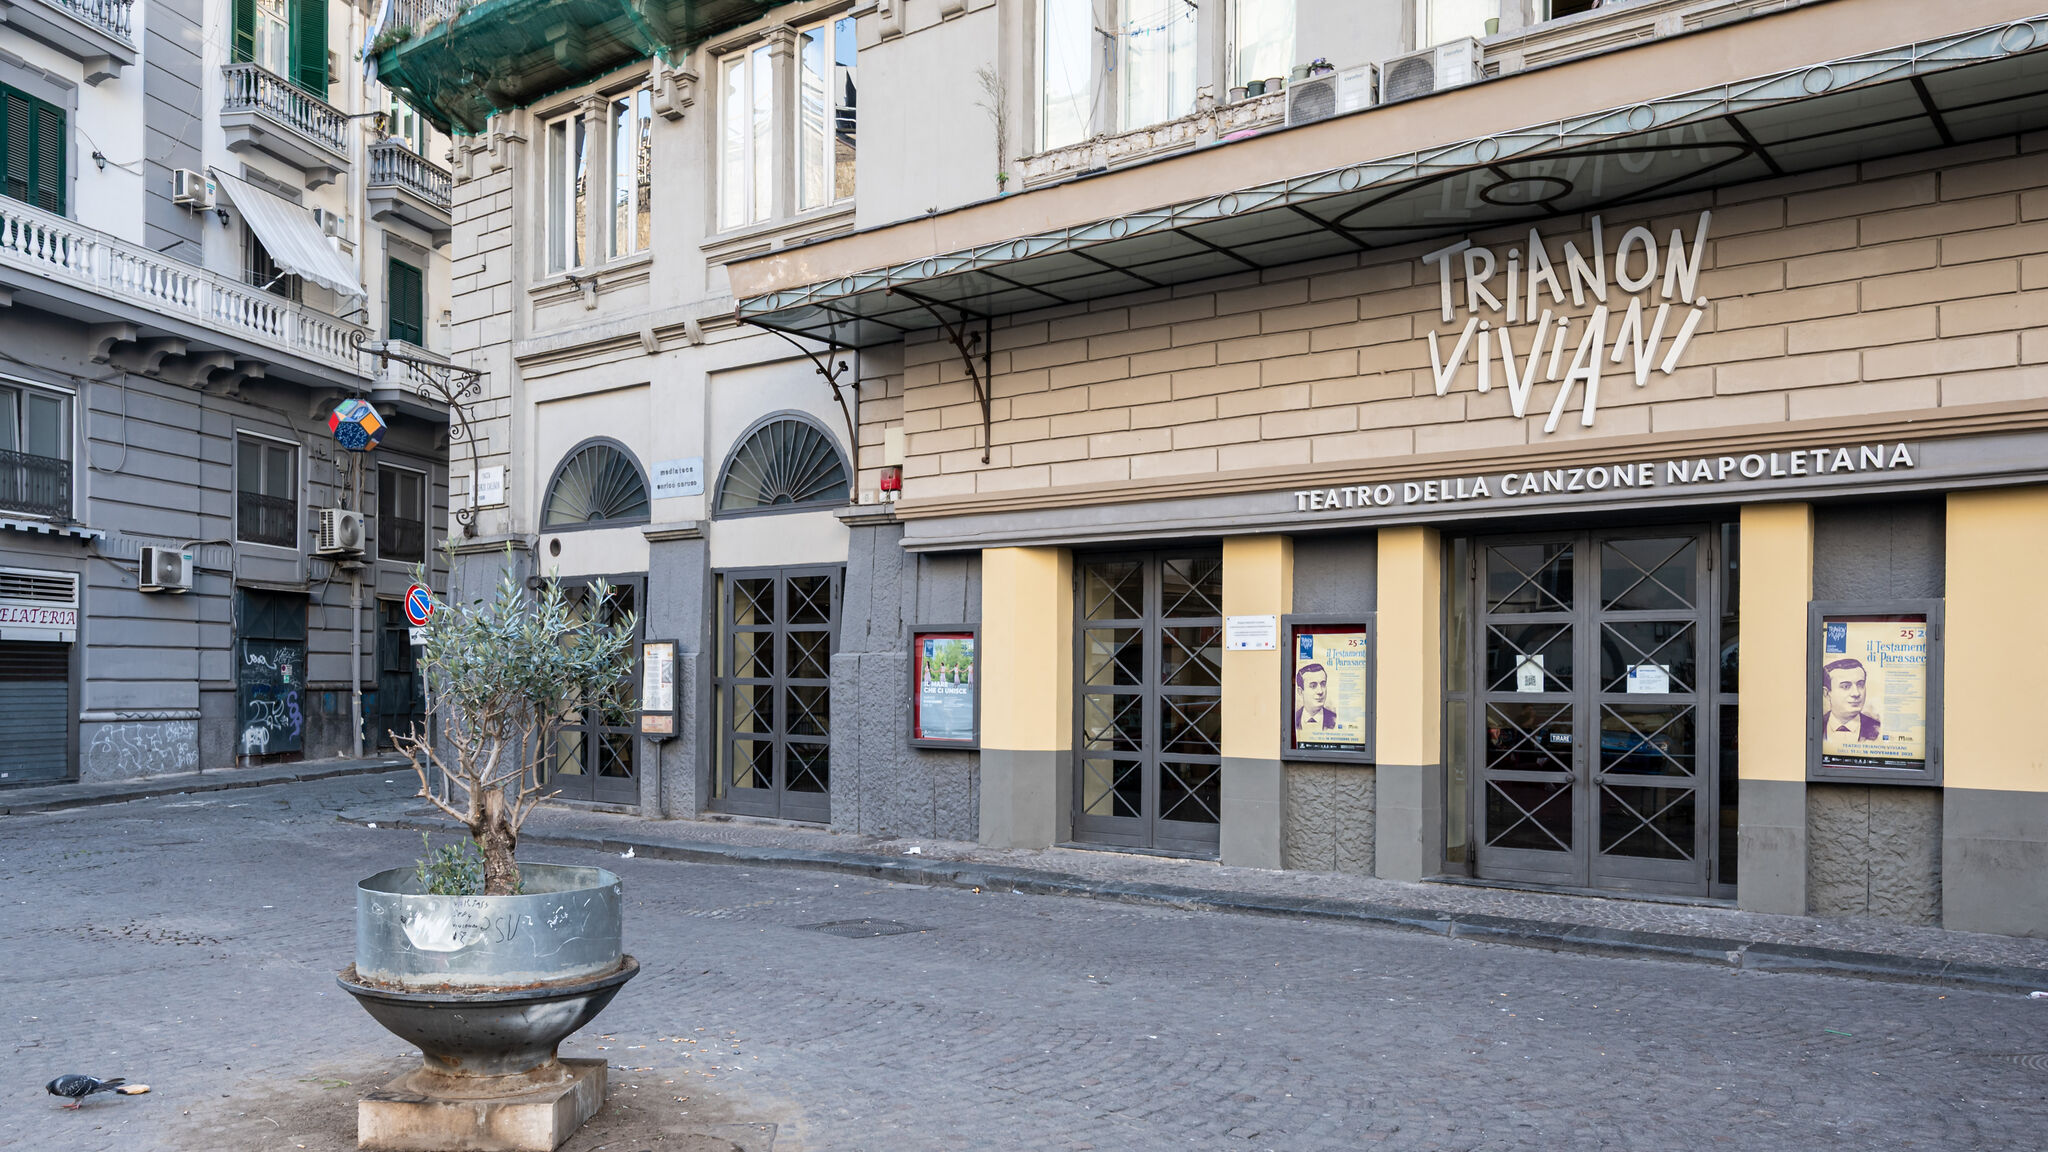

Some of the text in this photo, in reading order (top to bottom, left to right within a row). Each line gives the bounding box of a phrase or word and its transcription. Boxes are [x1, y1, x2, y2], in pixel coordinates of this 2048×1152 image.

[1294, 442, 1915, 512] TEATRO DELLA CANZONE NAPOLETANA
[657, 480, 697, 490] enrico caruso
[1901, 630, 1927, 639] 25 2
[1348, 639, 1358, 648] 25
[1866, 652, 1876, 662] di
